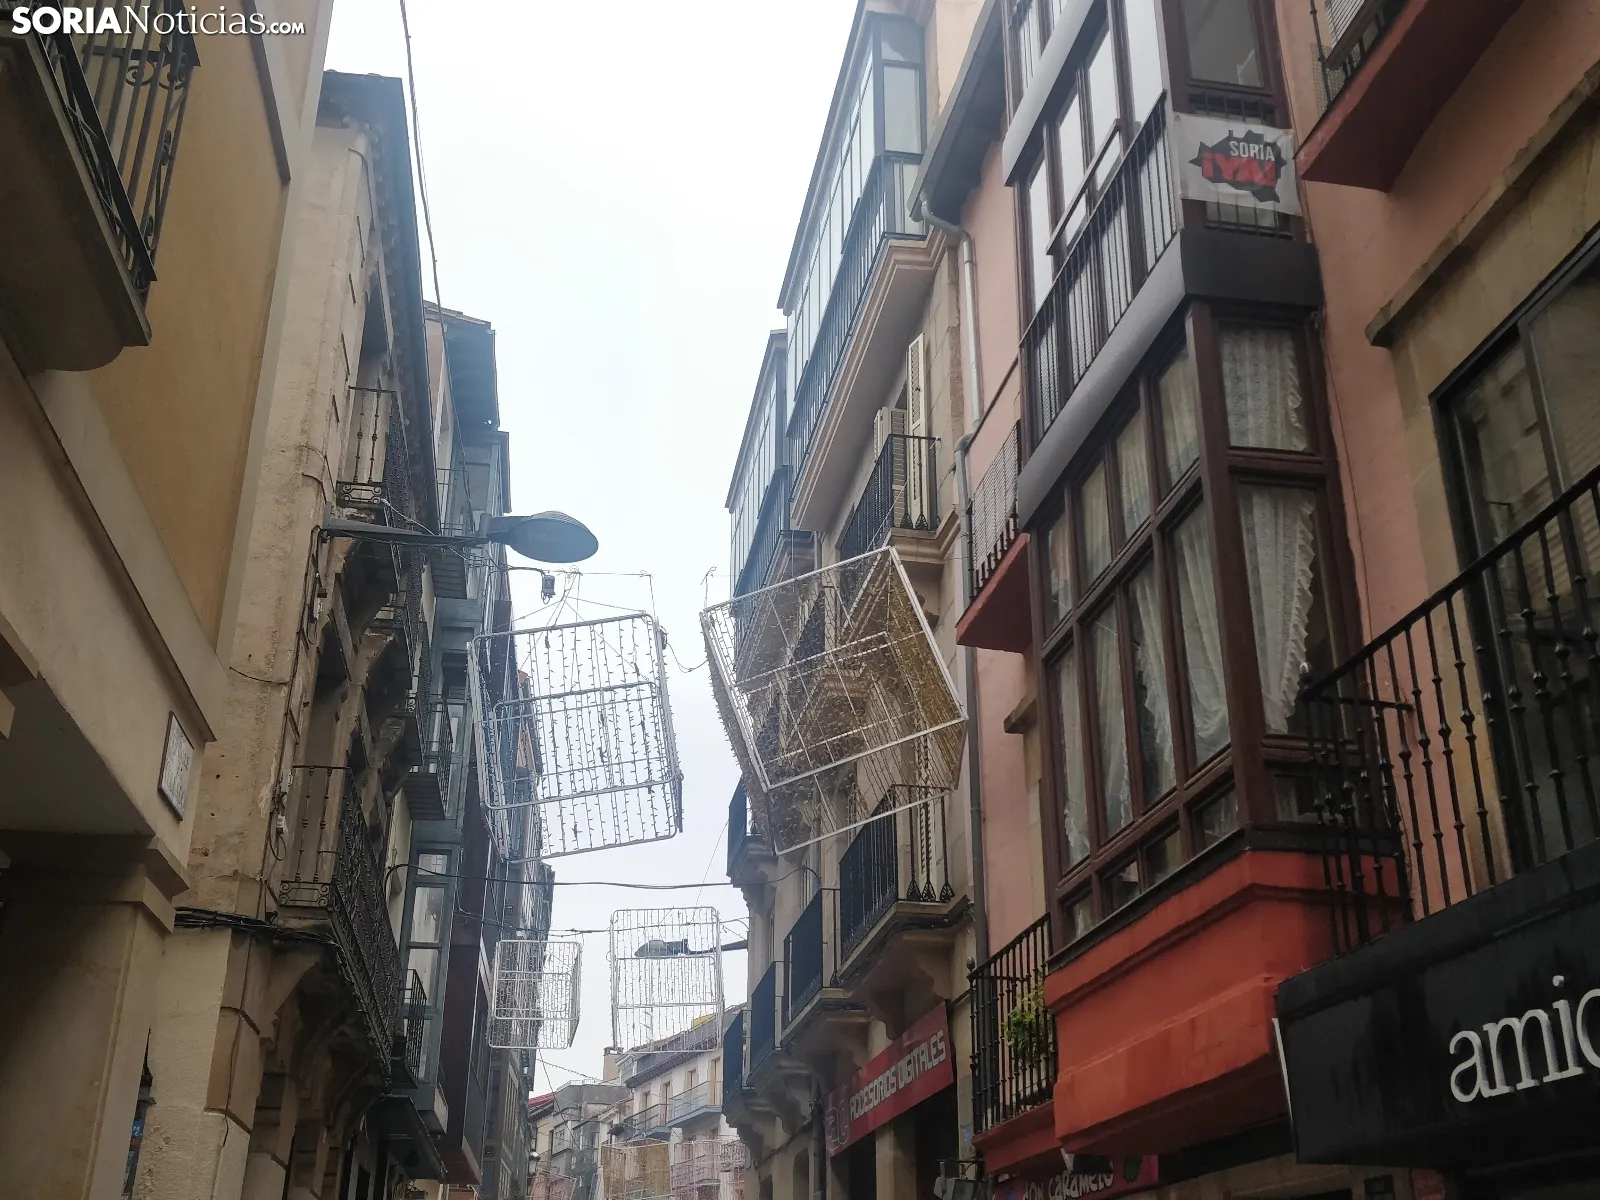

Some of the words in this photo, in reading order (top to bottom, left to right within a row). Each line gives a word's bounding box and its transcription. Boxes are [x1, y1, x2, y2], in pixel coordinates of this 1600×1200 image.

[1229, 140, 1276, 162] SORIA
[850, 1066, 897, 1122] ACCESORIOS
[897, 1030, 947, 1090] DIGITALES
